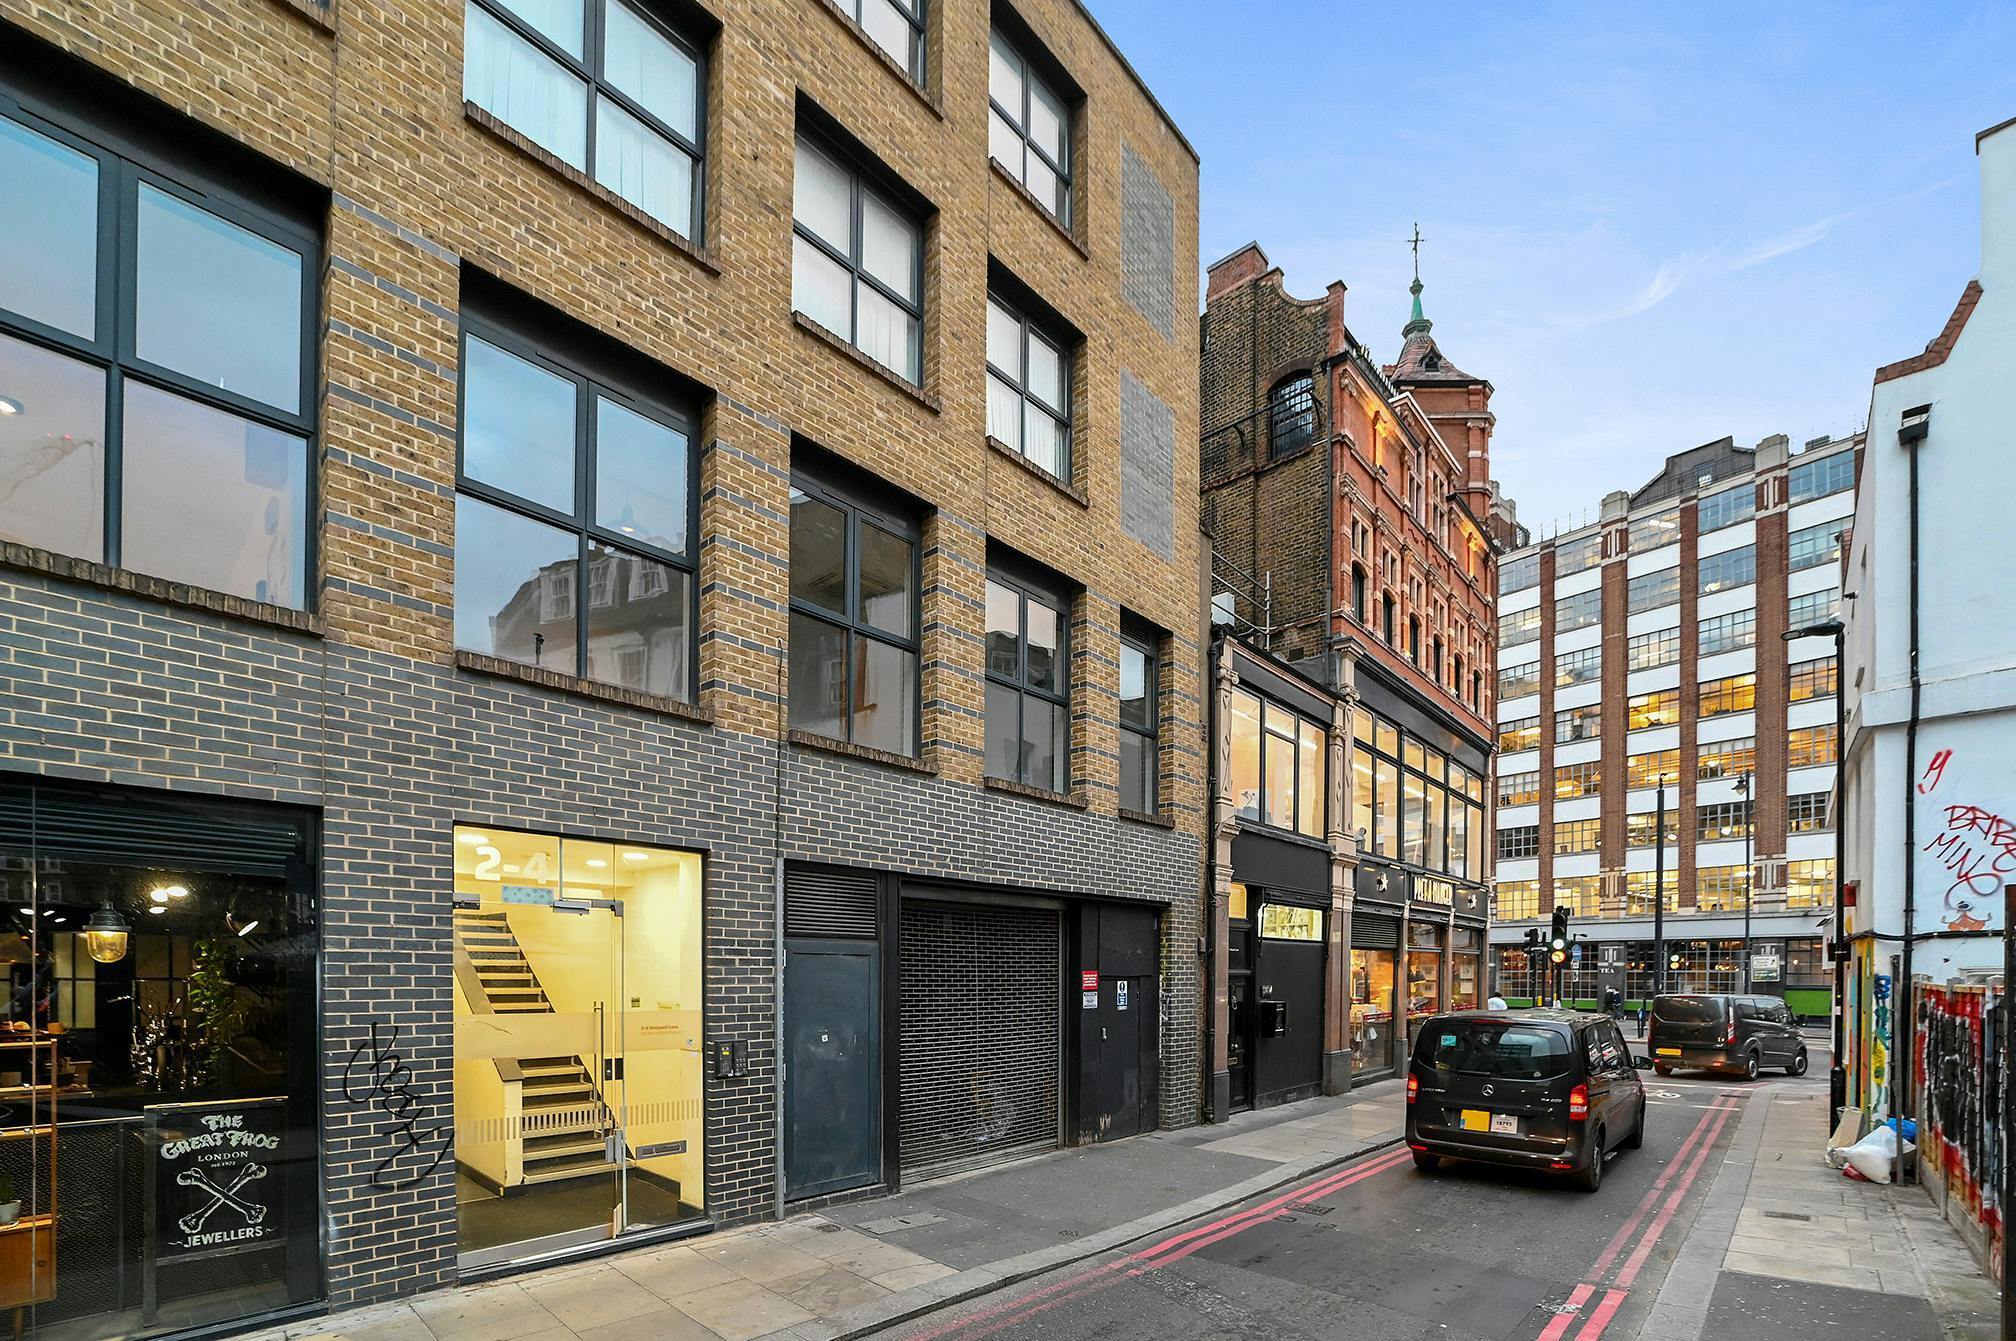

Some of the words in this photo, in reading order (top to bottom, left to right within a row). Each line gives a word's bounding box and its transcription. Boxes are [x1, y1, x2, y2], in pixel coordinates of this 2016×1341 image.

[475, 846, 547, 884] 2-4
[201, 1115, 243, 1131] THE
[160, 1132, 224, 1159] GREAT
[224, 1130, 280, 1149] FROG
[198, 1151, 249, 1162] LONDON
[184, 1226, 264, 1247] JEWELLERS
